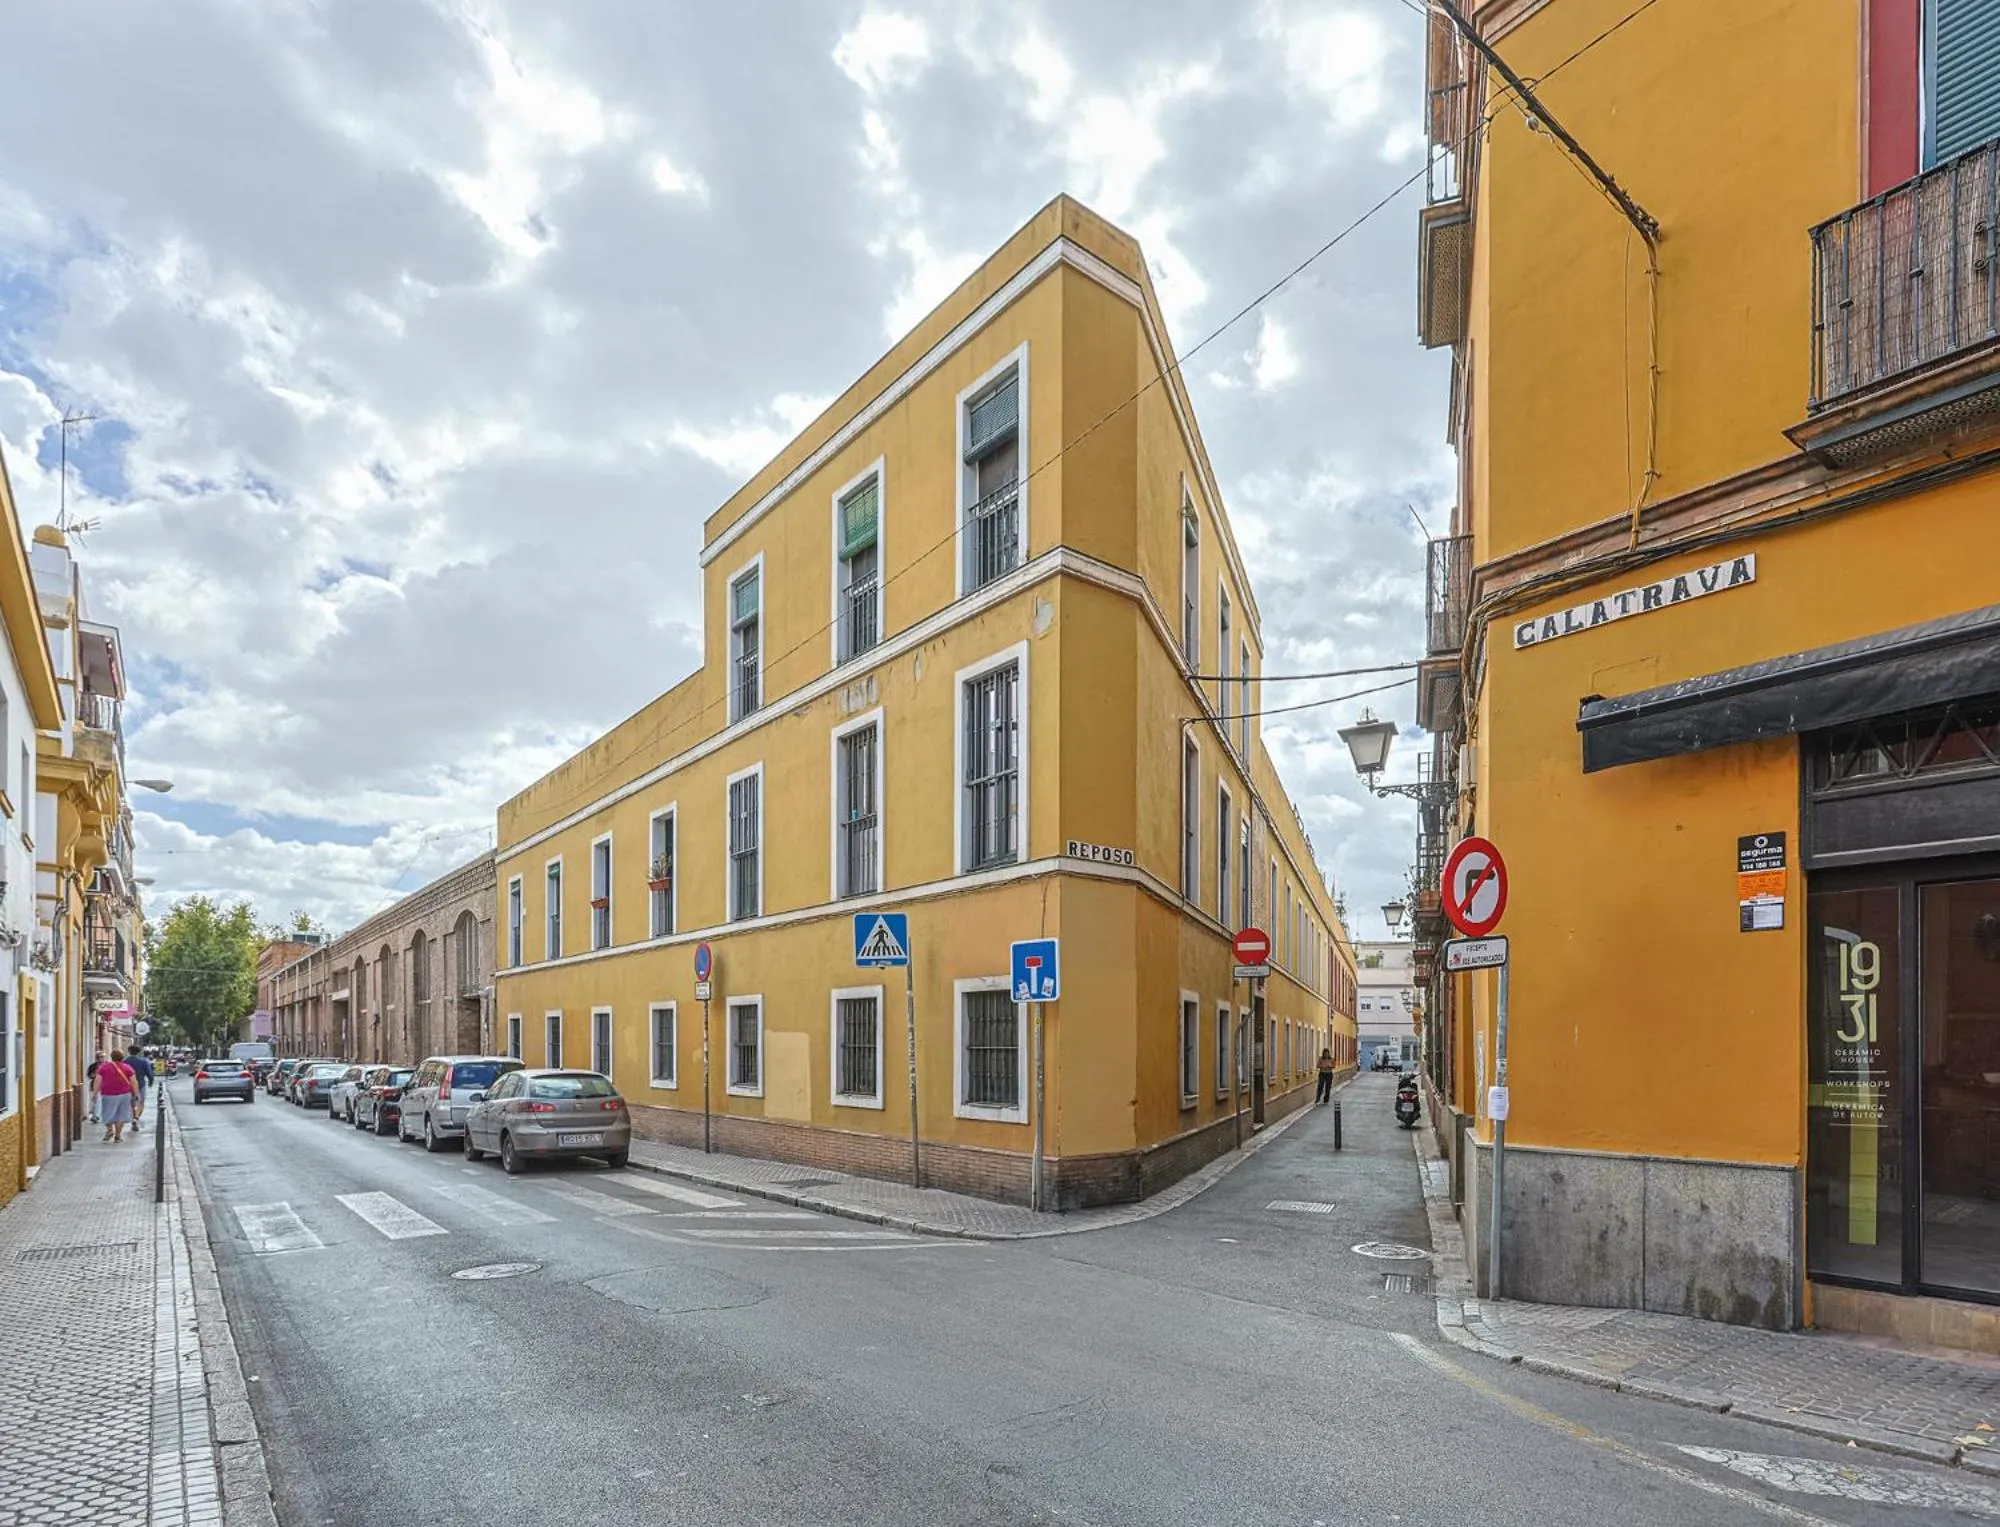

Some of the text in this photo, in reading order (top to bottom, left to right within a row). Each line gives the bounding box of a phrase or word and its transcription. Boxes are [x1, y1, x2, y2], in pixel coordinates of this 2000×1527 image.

[1516, 557, 1751, 646] CALATRAVA
[1069, 842, 1133, 865] REPOSO
[1741, 846, 1783, 858] segurma
[1834, 1048, 1881, 1056] CERAMIC
[1826, 1080, 1891, 1088] WORKSHOPS
